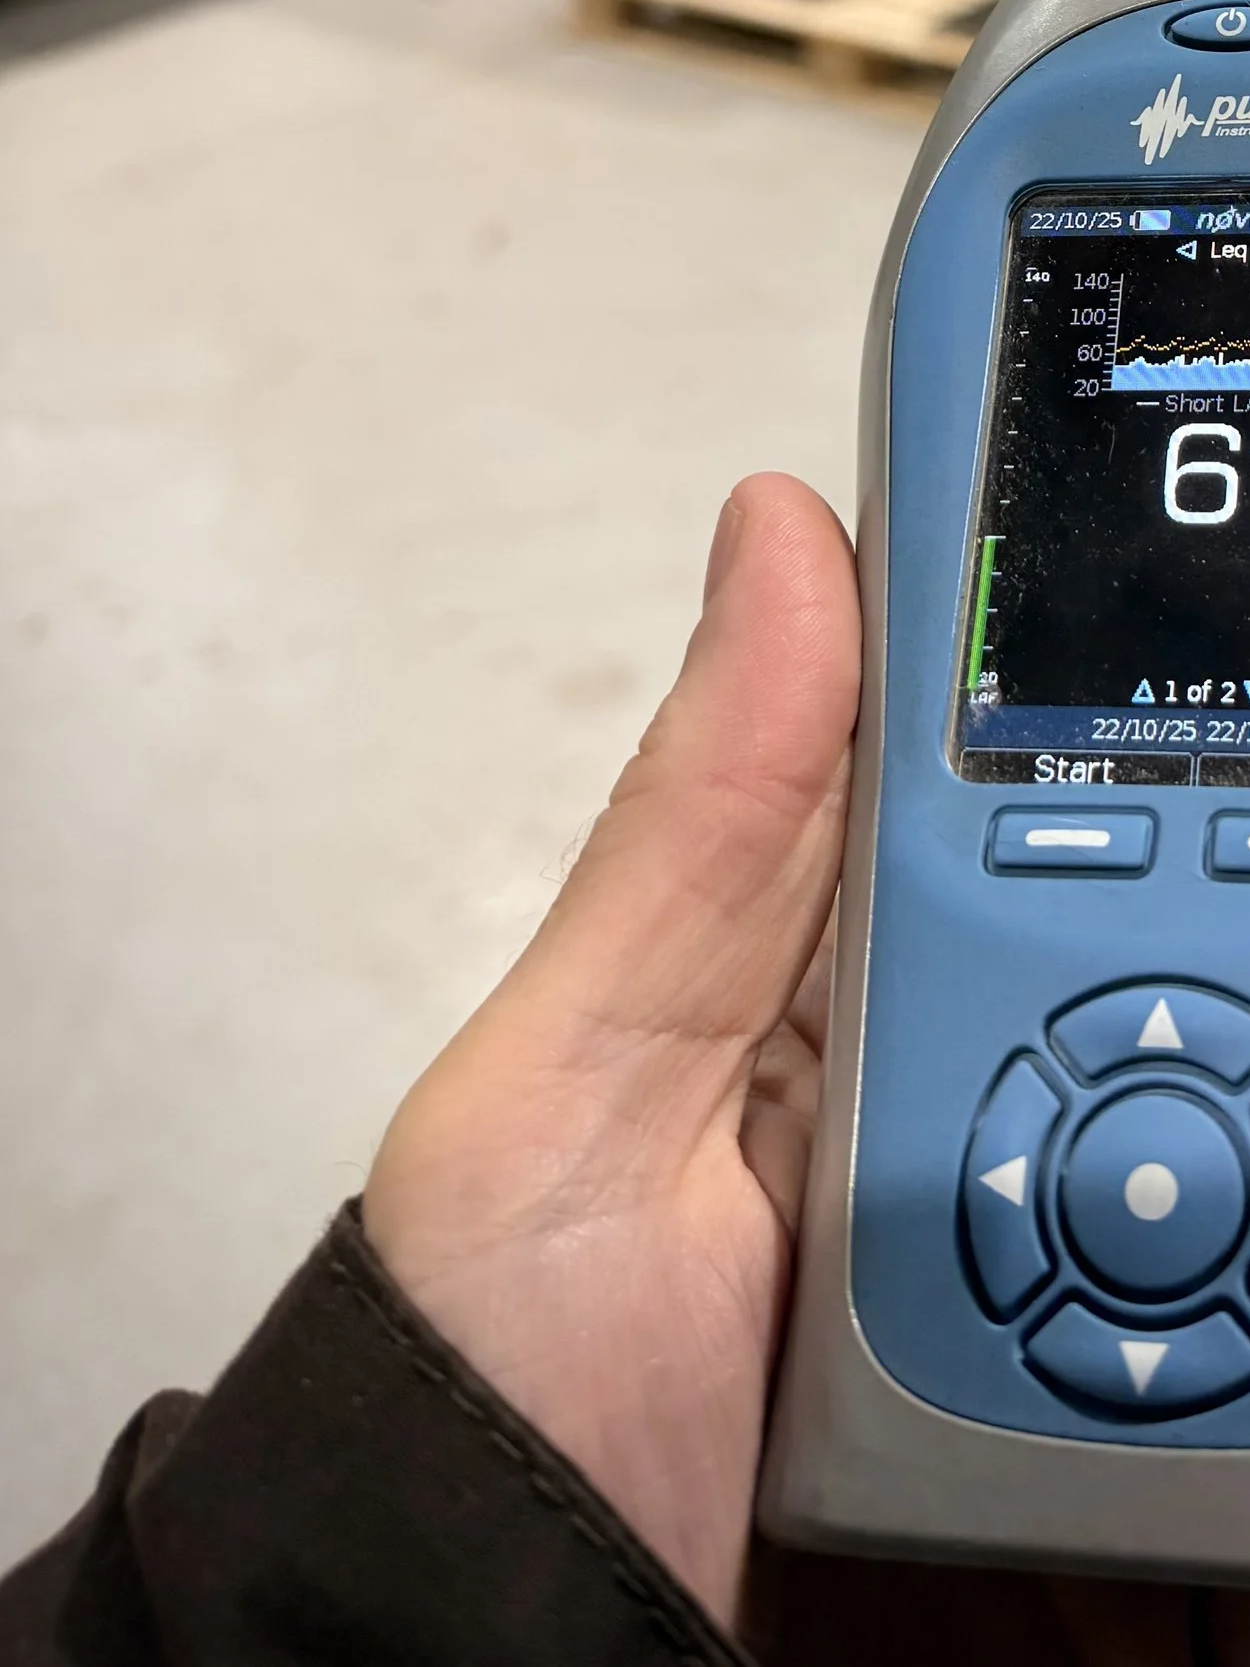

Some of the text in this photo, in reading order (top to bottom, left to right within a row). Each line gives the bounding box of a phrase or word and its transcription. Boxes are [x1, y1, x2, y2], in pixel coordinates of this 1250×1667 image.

[1030, 211, 1123, 231] 22/10/25
[1211, 240, 1248, 262] Leq
[1025, 271, 1050, 283] 140
[1073, 272, 1110, 291] 140
[1070, 308, 1106, 327] 100
[1077, 344, 1102, 362] 60
[1074, 379, 1099, 397] 20
[1164, 395, 1224, 413] Short
[978, 672, 998, 684] 20
[1165, 680, 1236, 705] 1 of 2
[1092, 718, 1197, 742] 22/10/25
[1034, 755, 1115, 784] Start
